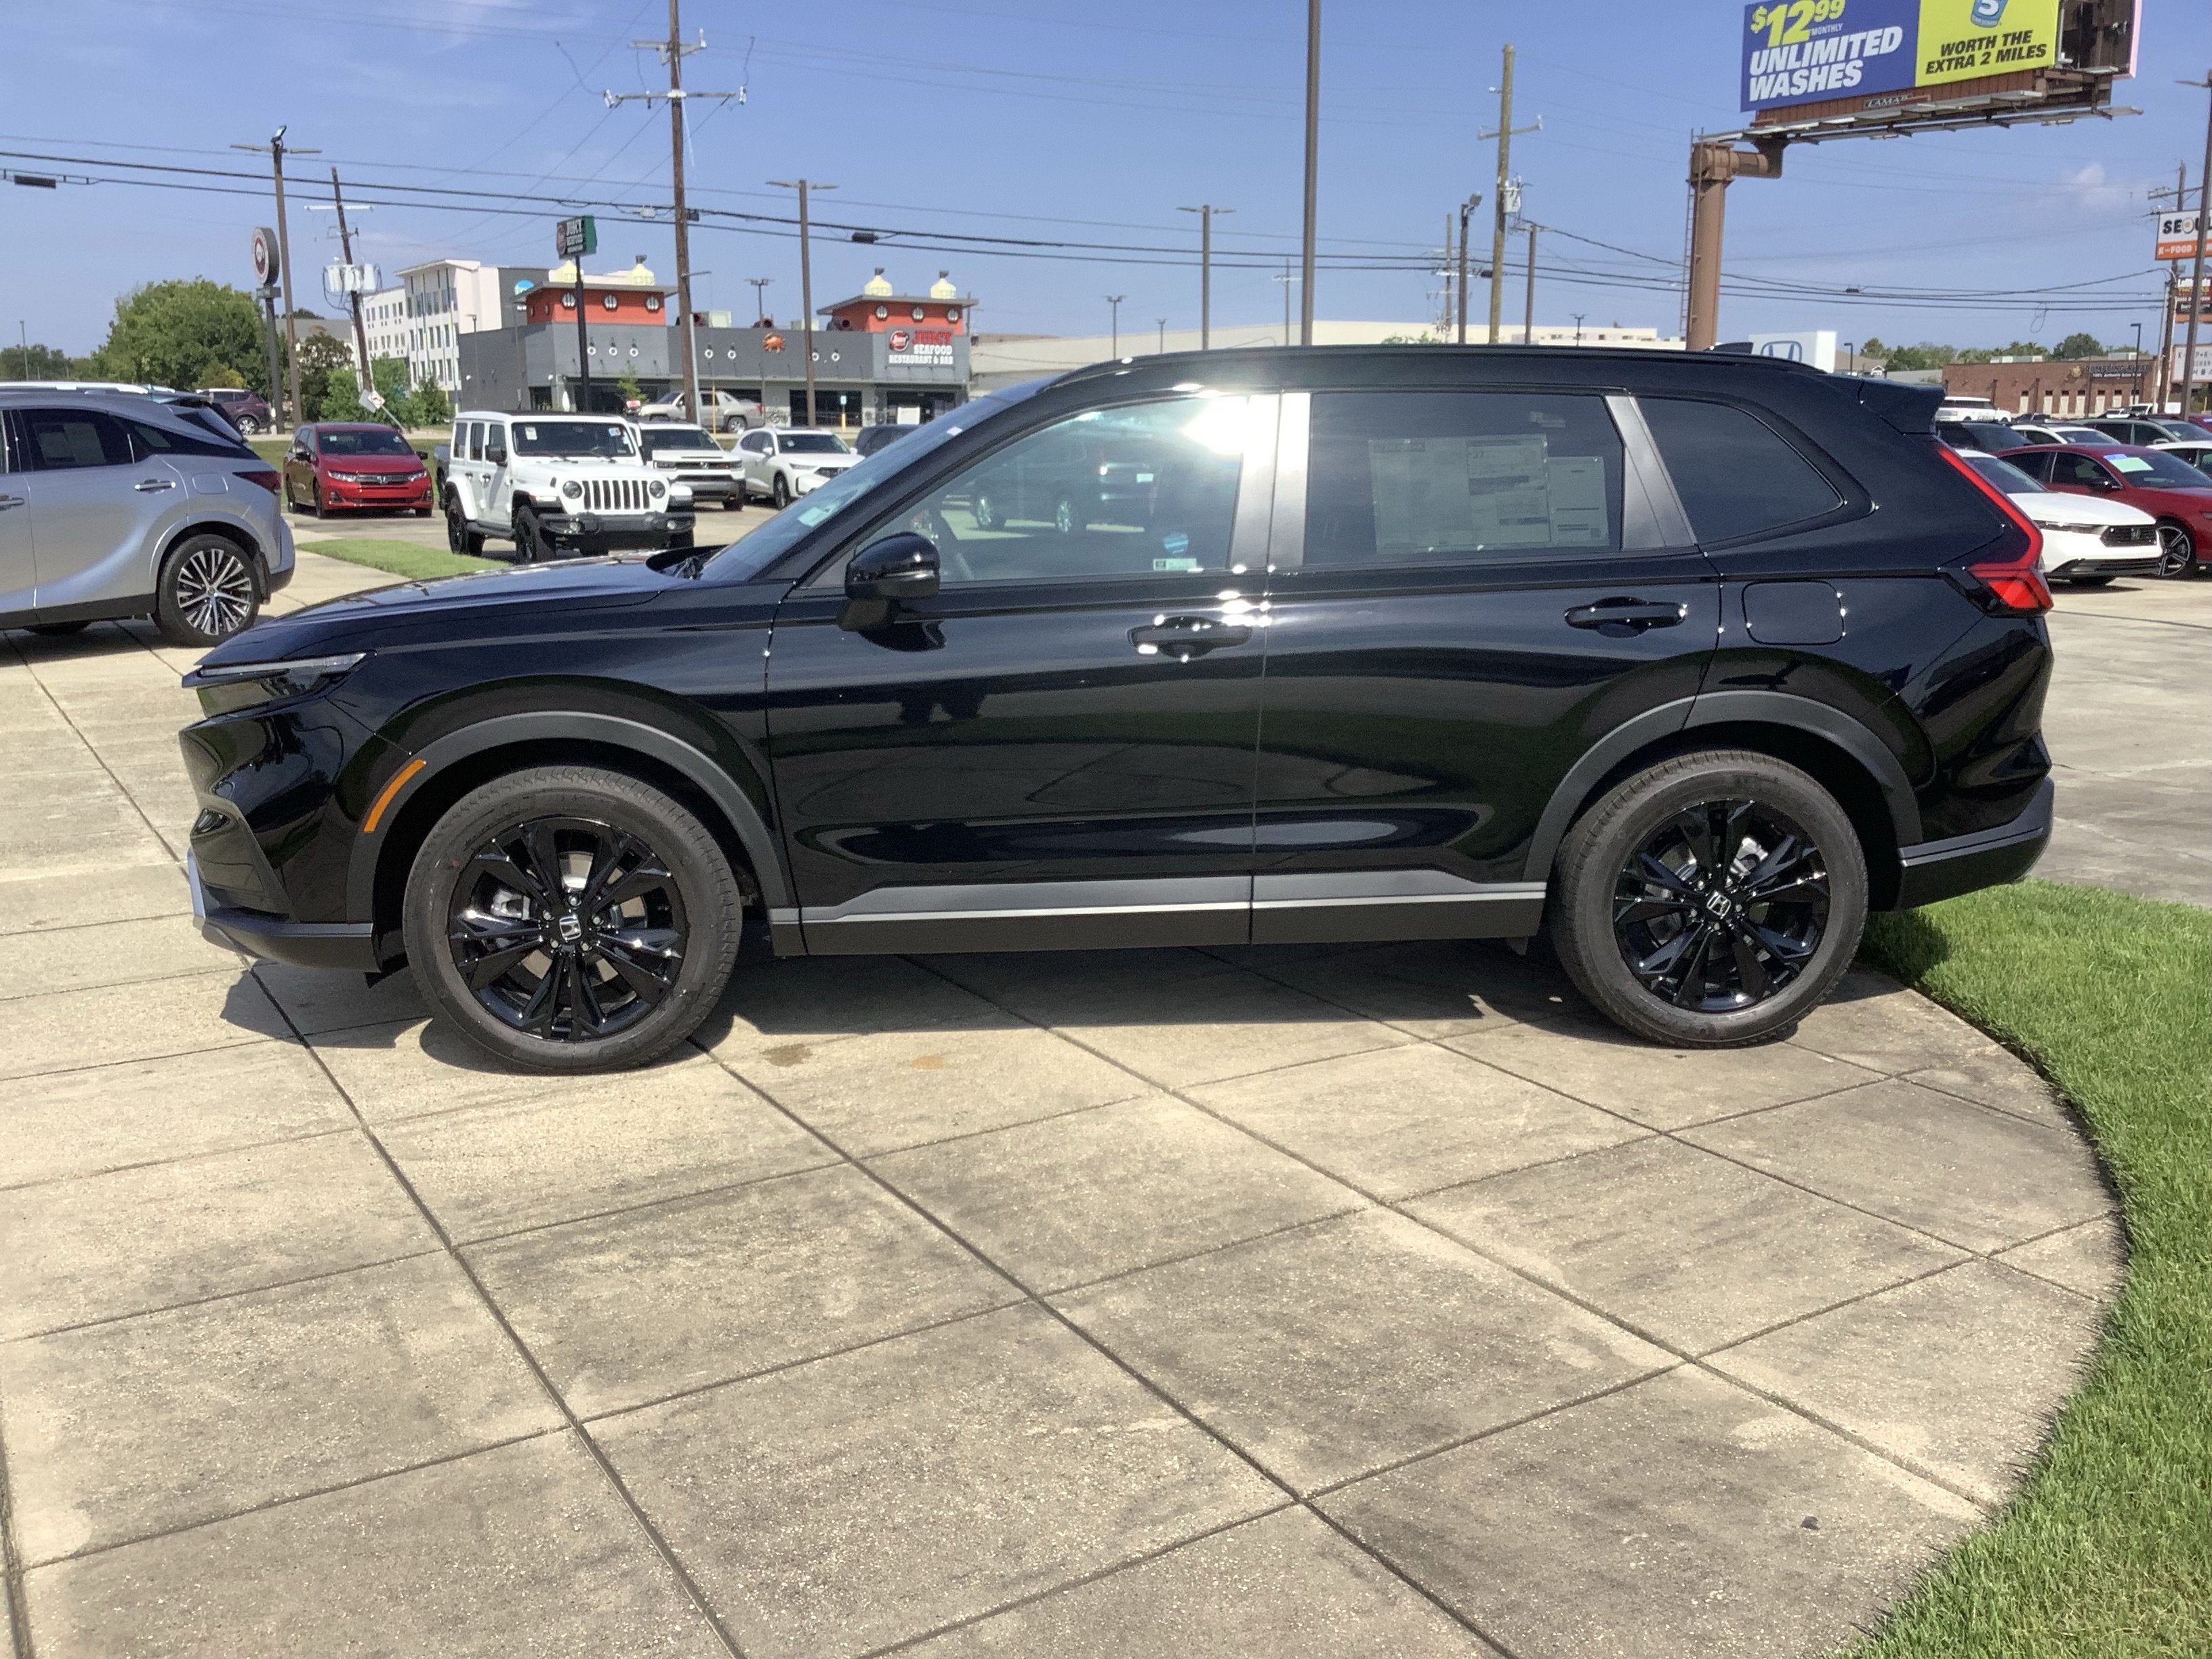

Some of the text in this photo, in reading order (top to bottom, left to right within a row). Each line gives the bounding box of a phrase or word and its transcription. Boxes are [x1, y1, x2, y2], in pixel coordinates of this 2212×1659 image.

[1811, 23, 1843, 36] MONTHLY
[1750, 26, 1903, 77] UNLIMITED
[1940, 30, 2033, 57] WORTH THE
[1925, 43, 2047, 75] EXTRA 2 MILES
[1749, 60, 1864, 102] WASHES
[566, 219, 581, 237] JUICY
[912, 330, 952, 345] JUICY
[914, 344, 953, 355] SEAFOOD
[888, 354, 933, 364] RESTAURANT
[940, 356, 954, 365] BAR
